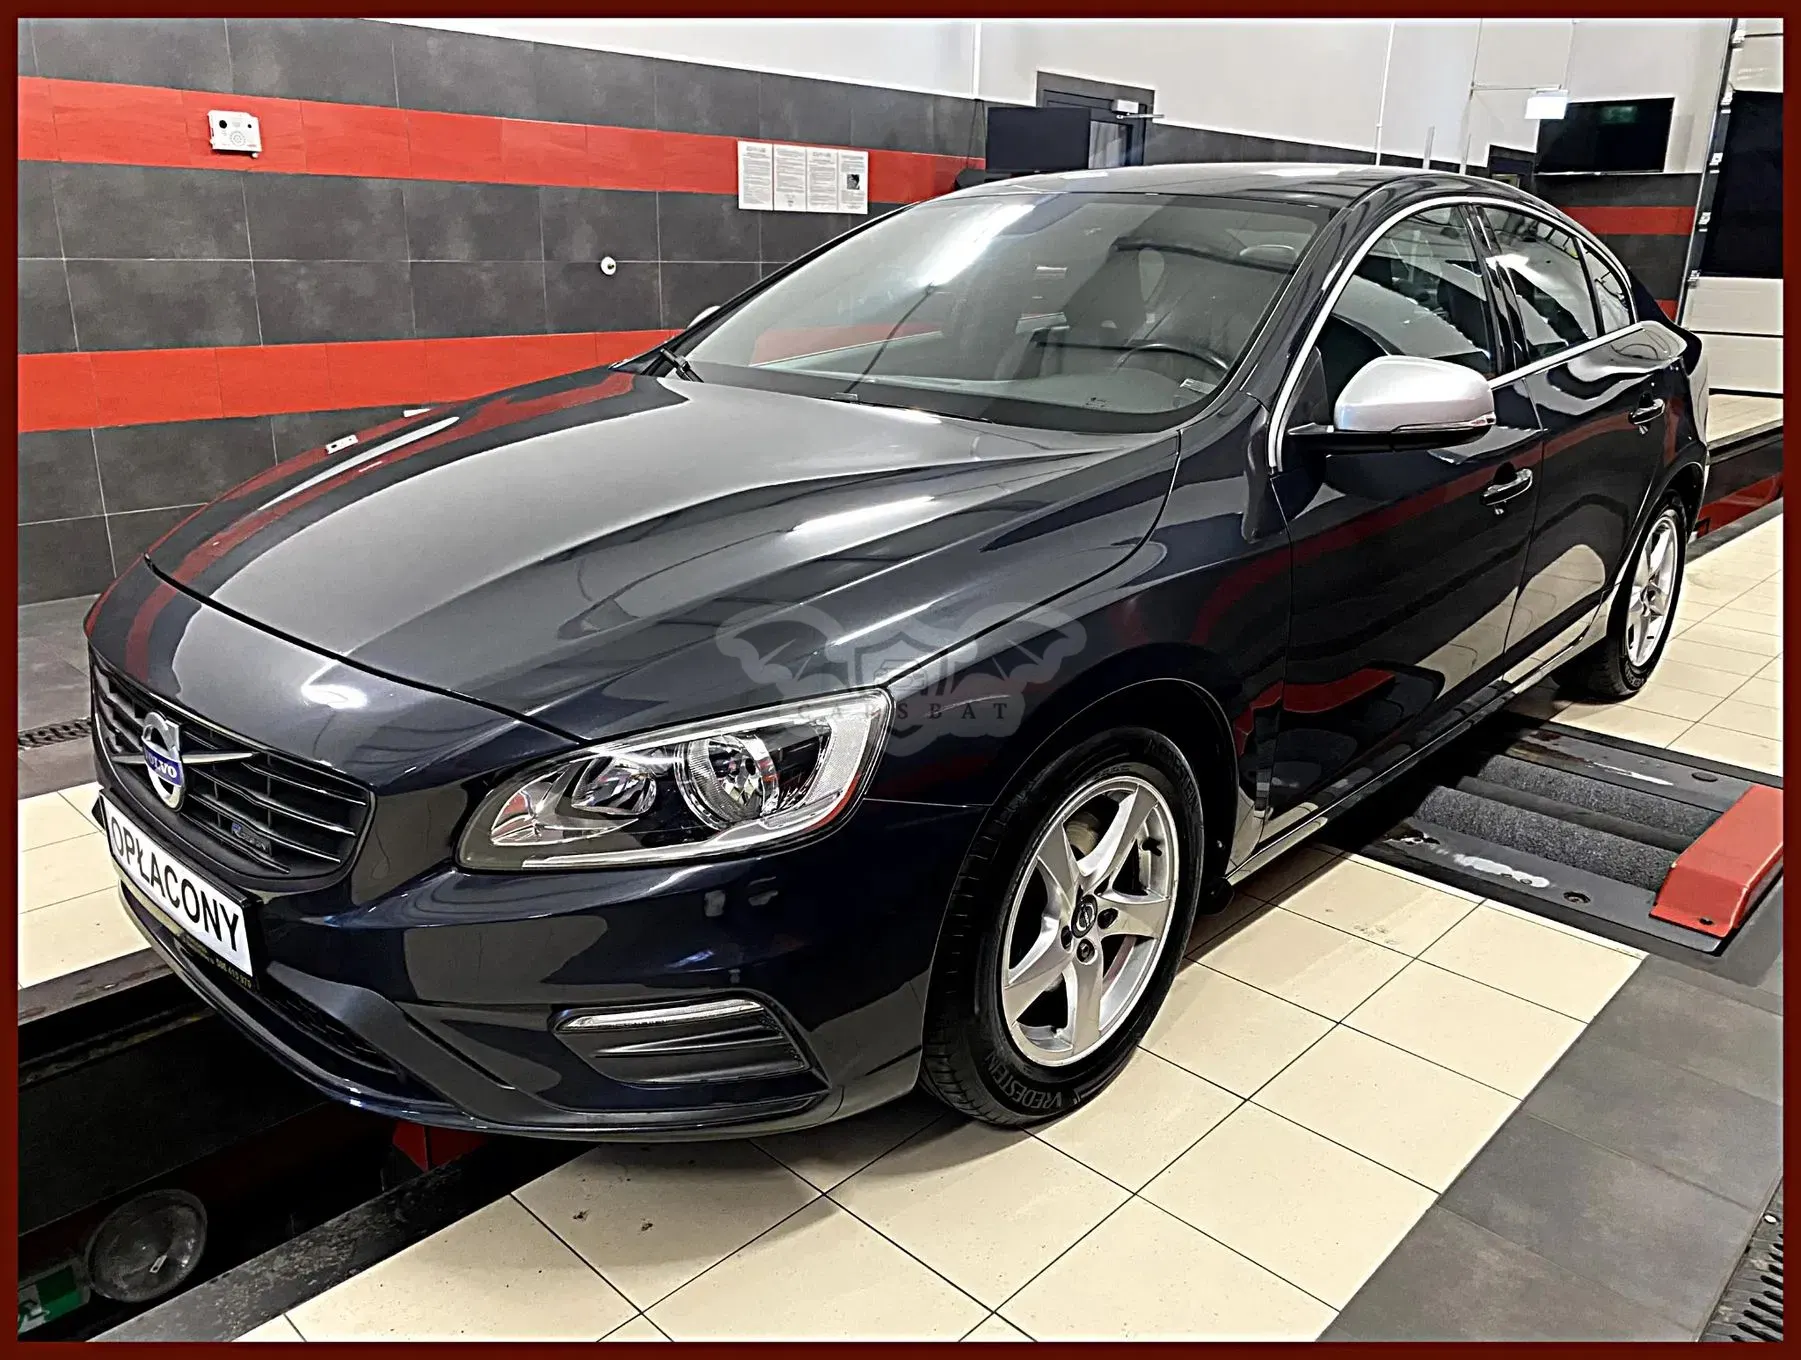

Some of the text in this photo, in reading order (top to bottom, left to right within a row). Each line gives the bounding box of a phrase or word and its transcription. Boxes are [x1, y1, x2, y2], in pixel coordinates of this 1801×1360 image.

[144, 748, 178, 779] VOLVO
[110, 816, 239, 952] OPŁACONY
[984, 1048, 1063, 1109] VREDESTEIN
